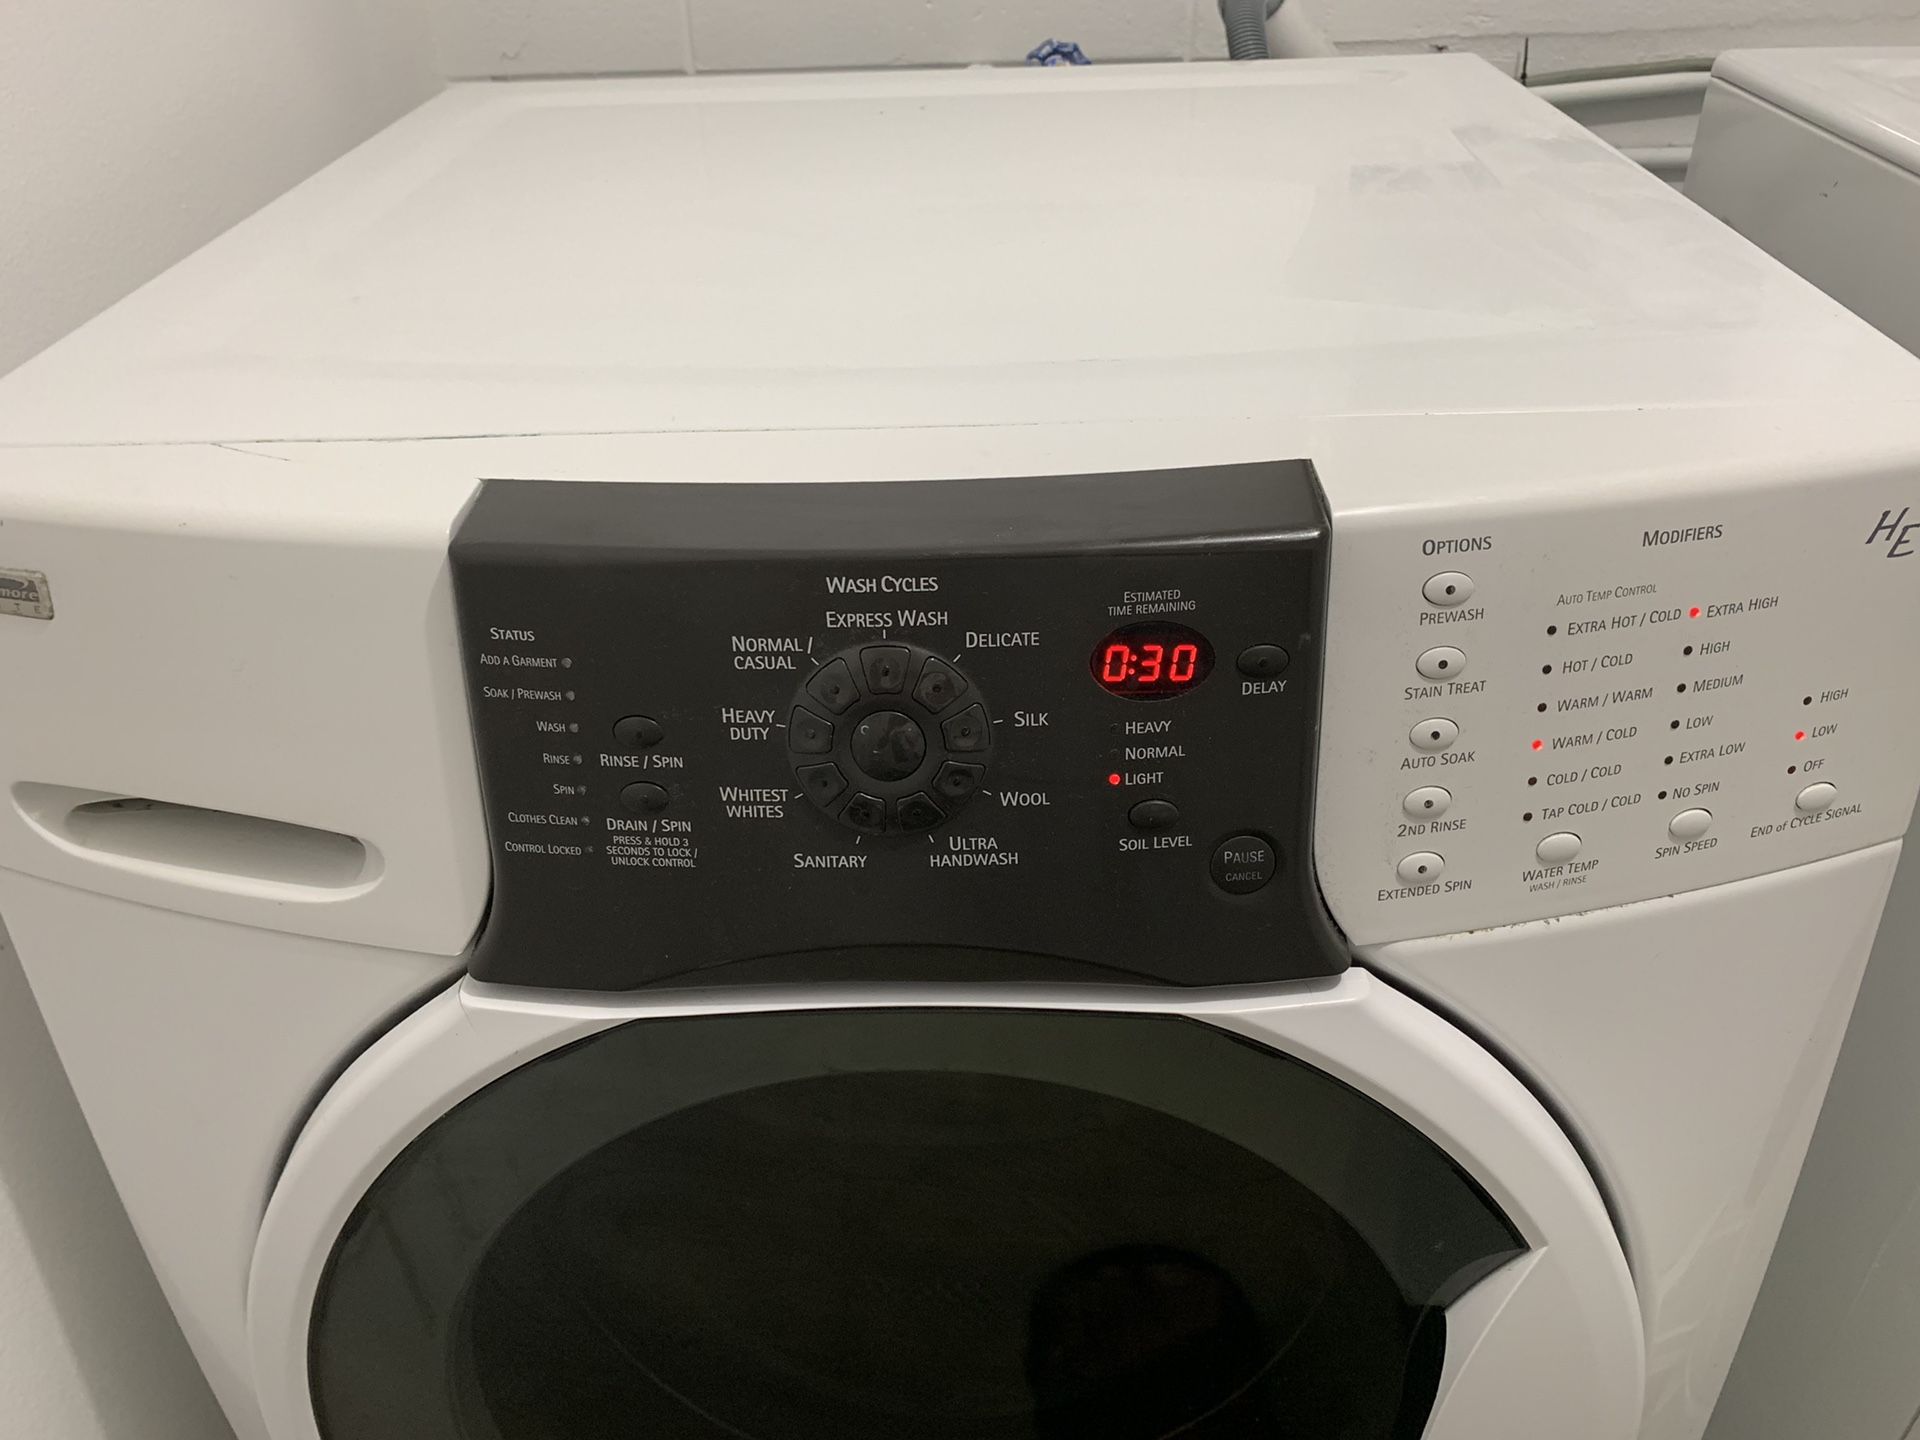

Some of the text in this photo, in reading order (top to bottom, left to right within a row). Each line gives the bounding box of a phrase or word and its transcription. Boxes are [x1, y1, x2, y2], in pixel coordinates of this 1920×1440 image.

[1642, 524, 1723, 547] MODIFIERS
[1422, 536, 1492, 556] OPTIONS
[826, 575, 938, 593] WASH CYCLES
[1123, 589, 1181, 603] ESTIMATED
[1556, 584, 1657, 606] AUTO TEMP CONTROL
[1108, 600, 1196, 616] TIME REMAINING
[1706, 596, 1779, 618] EXTRA HIGH
[826, 610, 948, 628] EXPRESS WASH
[1419, 608, 1485, 626] PREWASH
[1568, 620, 1606, 635] EXTRA
[1611, 615, 1637, 629] HOT
[1650, 608, 1682, 623] COLD
[490, 627, 535, 641] STATUS
[965, 631, 1040, 648] DELICATE
[731, 636, 803, 652] NORMAL
[1700, 641, 1731, 656] HIGH
[480, 654, 557, 667] ADD A GARMENT
[734, 656, 796, 670] CASUAL
[1102, 644, 1198, 682] 0:30
[1562, 659, 1588, 674] HOT
[1601, 653, 1633, 668] COLD
[1242, 680, 1287, 696] DELAY
[1404, 680, 1487, 700] STAIN TREAT
[1692, 674, 1744, 693] MEDIUM
[483, 687, 509, 698] SOAK
[517, 688, 561, 701] PREWASH
[1557, 696, 1599, 712] WARM
[1612, 687, 1653, 704] WARM
[1820, 688, 1849, 703] HIGH
[722, 708, 775, 724] HEAVY
[1014, 711, 1049, 726] SILK
[1686, 715, 1714, 730] LOW
[536, 721, 565, 732] WASH
[730, 727, 770, 741] DUTY
[1125, 721, 1172, 734] HEAVY
[1812, 724, 1838, 738] LOW
[1552, 733, 1593, 750] WARM
[1606, 726, 1638, 741] COLD
[543, 753, 570, 765] RINSE
[1125, 746, 1186, 760] NORMAL
[1401, 751, 1476, 770] AUTO SOAK
[1679, 742, 1746, 764] EXTRA LOW
[600, 754, 639, 767] RINSE
[653, 755, 683, 768] SPIN
[1803, 759, 1825, 773] OFF
[1125, 772, 1164, 786] LIGHT
[1547, 771, 1578, 786] COLD
[1591, 764, 1622, 779] COLD
[553, 784, 574, 795] SPIN
[720, 787, 788, 802] WHITEST
[1672, 782, 1720, 799] NO SPIN
[1000, 792, 1050, 806] WOOL
[726, 806, 784, 818] WHITES
[1542, 807, 1564, 820] TAP
[1568, 801, 1599, 815] COLD
[1611, 794, 1641, 808] COLD
[508, 812, 578, 825] CLOTHES CLEAN
[606, 818, 647, 831] DRAIN
[661, 819, 691, 832] SPIN
[1750, 804, 1863, 838] END of CYCLE SIGNAL
[1397, 819, 1467, 838] 2ND RINSE
[613, 836, 689, 846] PRESS & HOLD 3
[949, 836, 998, 851] ULTRA
[1119, 836, 1192, 851] SOIL LEVEL
[1655, 838, 1718, 859] SPIN SPEED
[505, 842, 581, 856] CONTROL LOCKED
[606, 846, 650, 856] SECONDS
[653, 847, 666, 856] TO
[667, 848, 692, 857] LOCK
[611, 856, 696, 868] UNLOCK CONTROL
[794, 853, 867, 868] SANITARY
[930, 853, 1019, 868] HANDWASH
[1224, 850, 1265, 864] PAUSE
[1225, 872, 1262, 881] CANCEL
[1523, 860, 1599, 882] WATER TEMP
[1378, 880, 1472, 902] EXTENDED SPIN
[1529, 882, 1555, 892] WASH
[1563, 875, 1587, 887] RINSE
